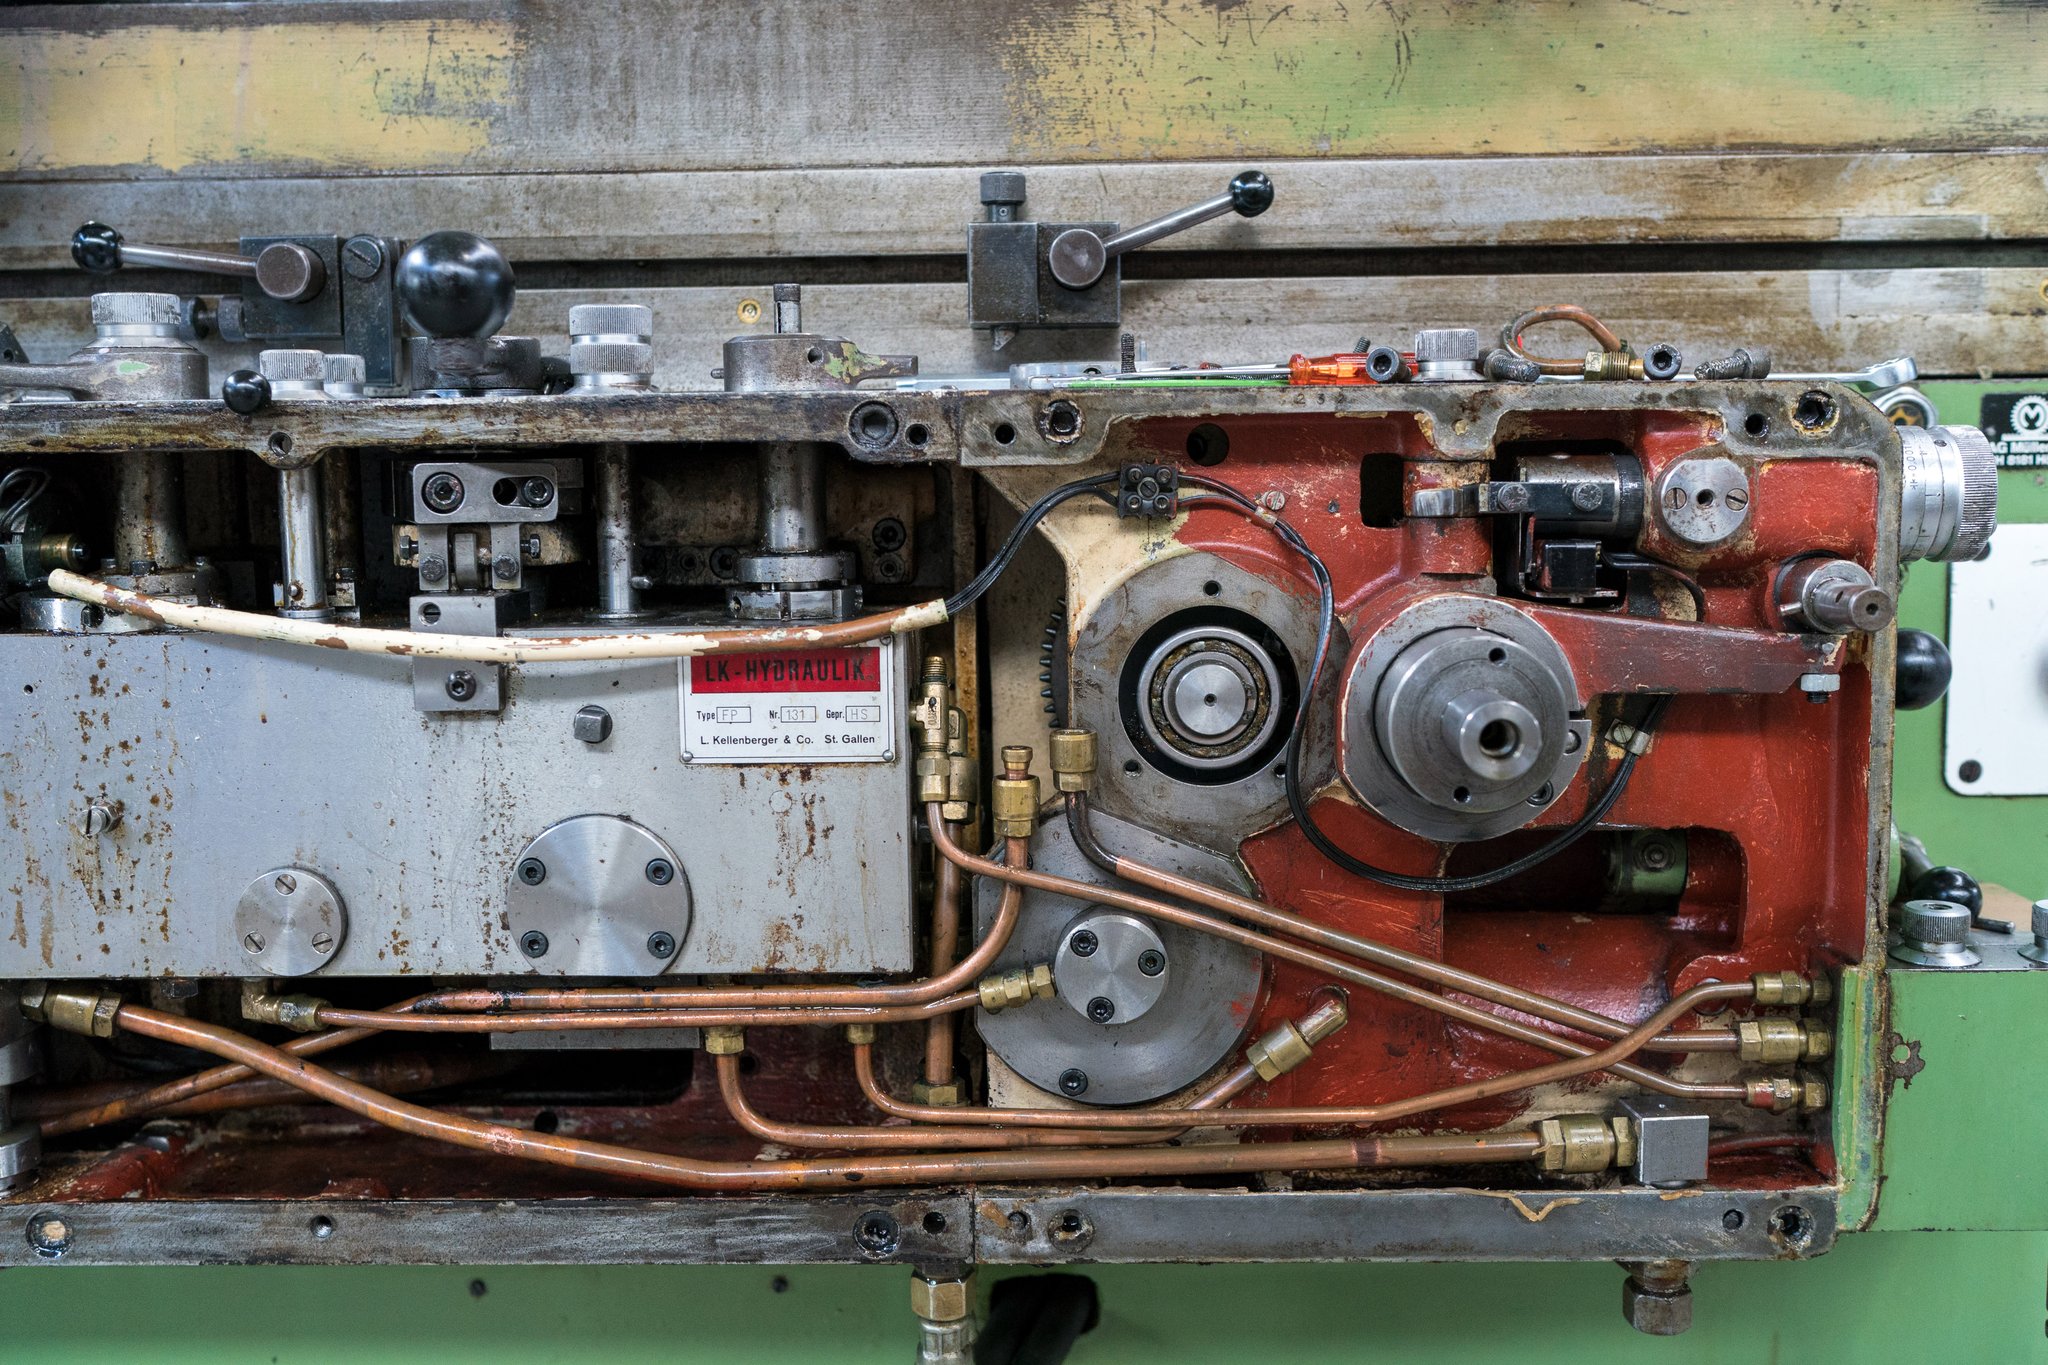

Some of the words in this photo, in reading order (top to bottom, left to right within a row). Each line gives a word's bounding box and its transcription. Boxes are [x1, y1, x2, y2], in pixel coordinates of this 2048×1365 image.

[2010, 441, 2048, 454] Mülle
[706, 659, 864, 681] LK-HYDRAULIK
[696, 710, 716, 721] Type
[722, 709, 738, 720] FP
[769, 710, 780, 719] Nr.
[786, 709, 805, 720] 131
[826, 709, 844, 720] Gepr.
[850, 708, 868, 720] HS
[700, 736, 709, 745] L.
[713, 735, 778, 746] Kellenberger
[783, 735, 791, 744] &
[796, 735, 814, 744] Co.
[824, 734, 838, 744] St.
[841, 734, 875, 744] Gallen
